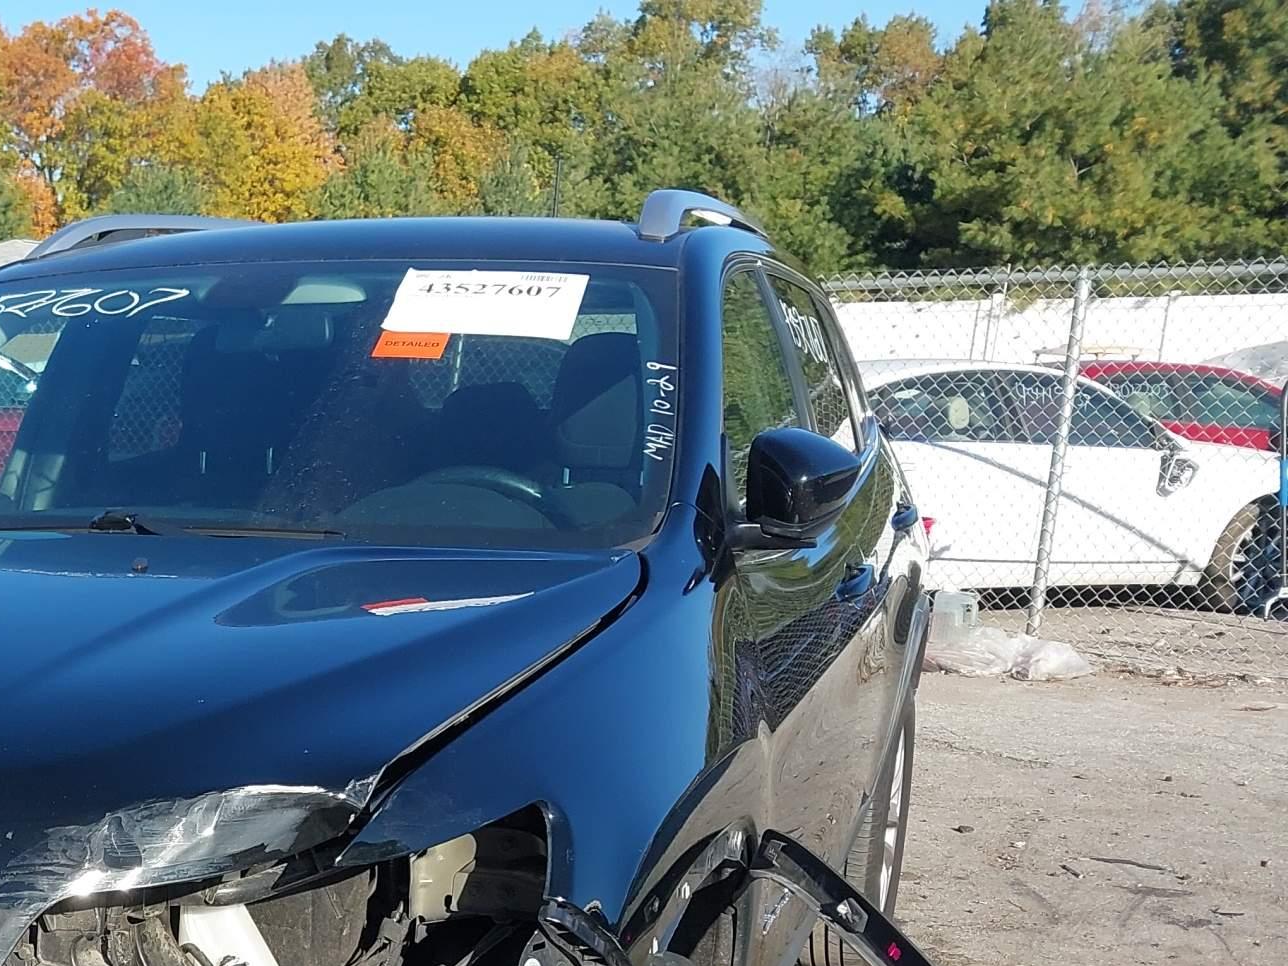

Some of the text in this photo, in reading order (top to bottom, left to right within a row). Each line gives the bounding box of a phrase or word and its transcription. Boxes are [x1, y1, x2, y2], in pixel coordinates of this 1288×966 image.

[417, 282, 563, 299] 43527607
[383, 339, 441, 348] DETAILED
[646, 361, 678, 416] 10-29
